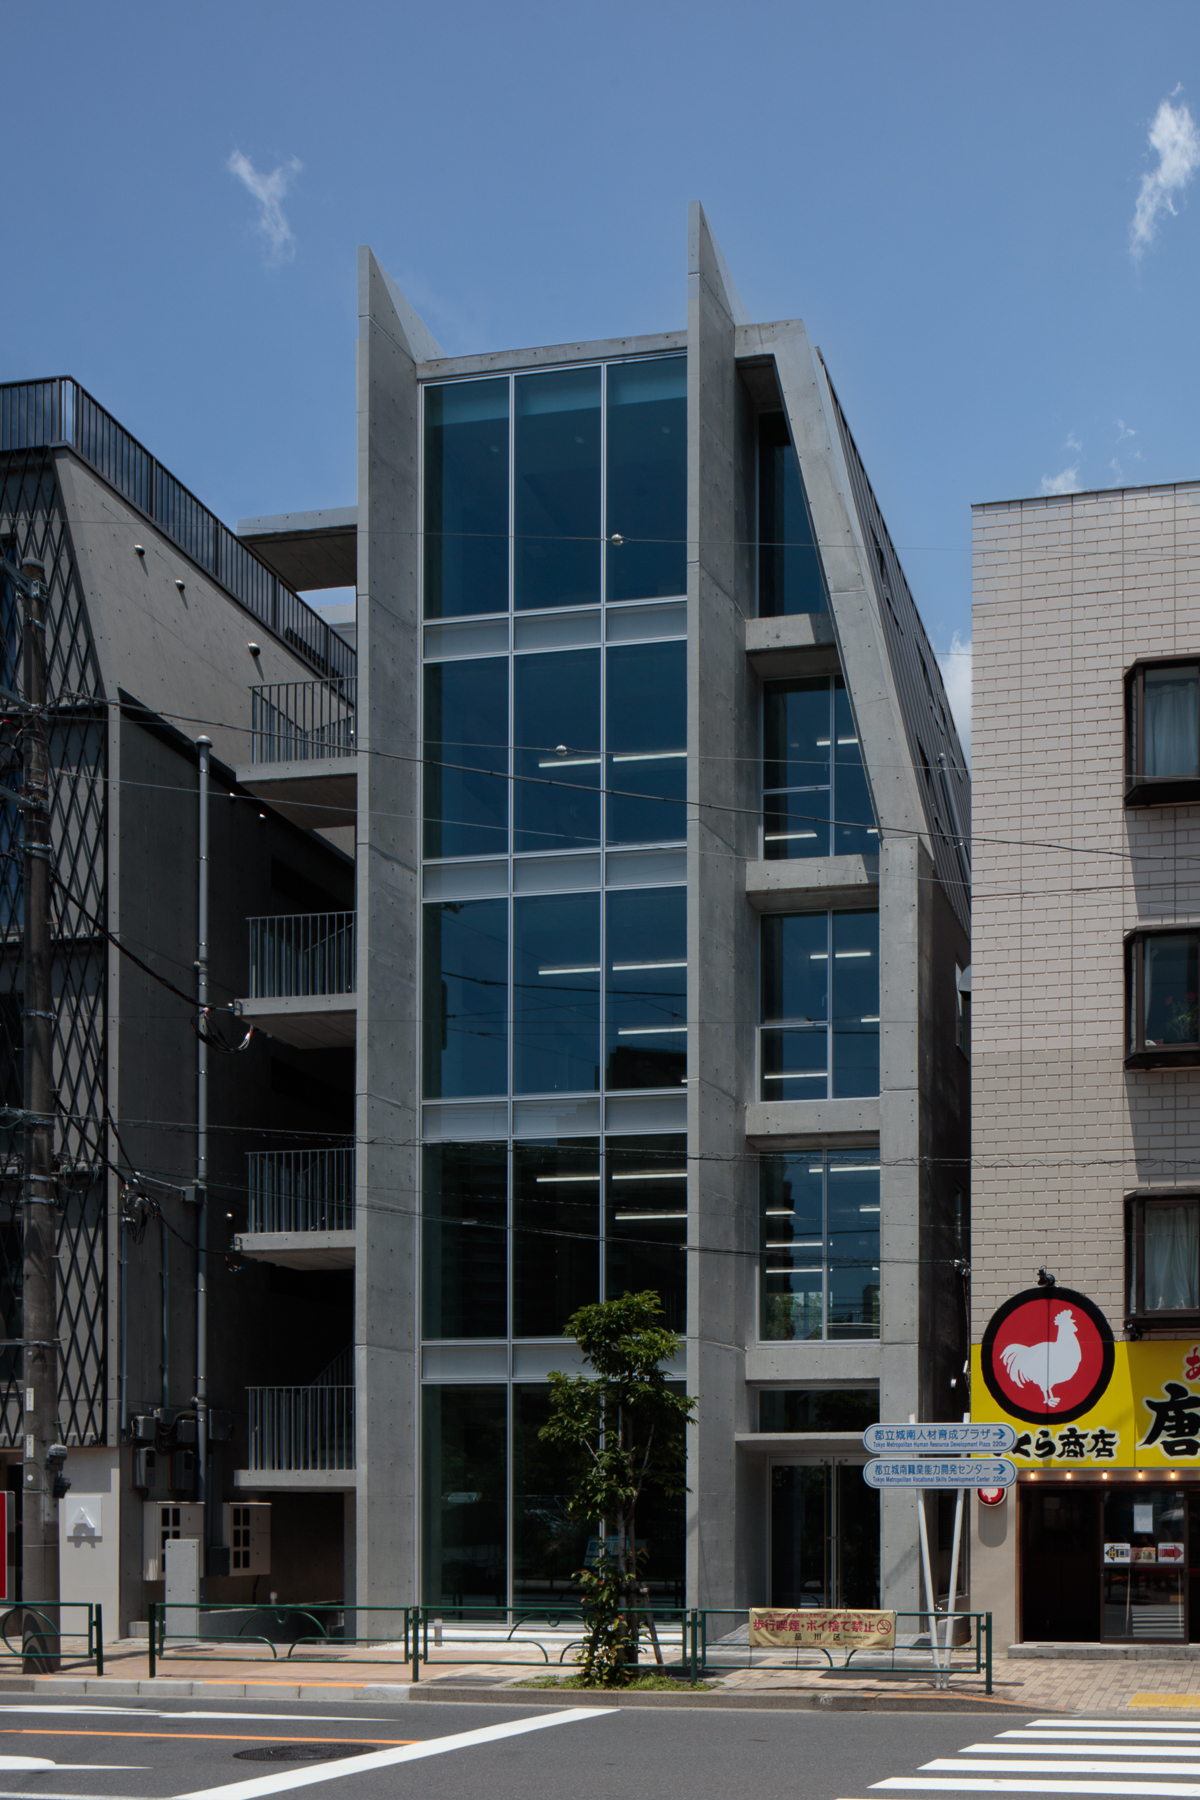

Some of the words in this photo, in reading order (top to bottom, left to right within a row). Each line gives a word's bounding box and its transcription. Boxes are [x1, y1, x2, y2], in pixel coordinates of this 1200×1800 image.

[874, 1429, 991, 1441] 都立城南人材育成プラザ
[873, 1441, 886, 1449] Tokyo
[886, 1441, 913, 1449] Metropolitan
[950, 1441, 979, 1449] Development
[992, 1427, 1117, 1458] くら商店
[874, 1464, 990, 1475] 都立城南職業能力開発センター
[885, 1476, 912, 1484] Metropolitan
[948, 1476, 976, 1484] Development
[1107, 1549, 1126, 1558] 出口
